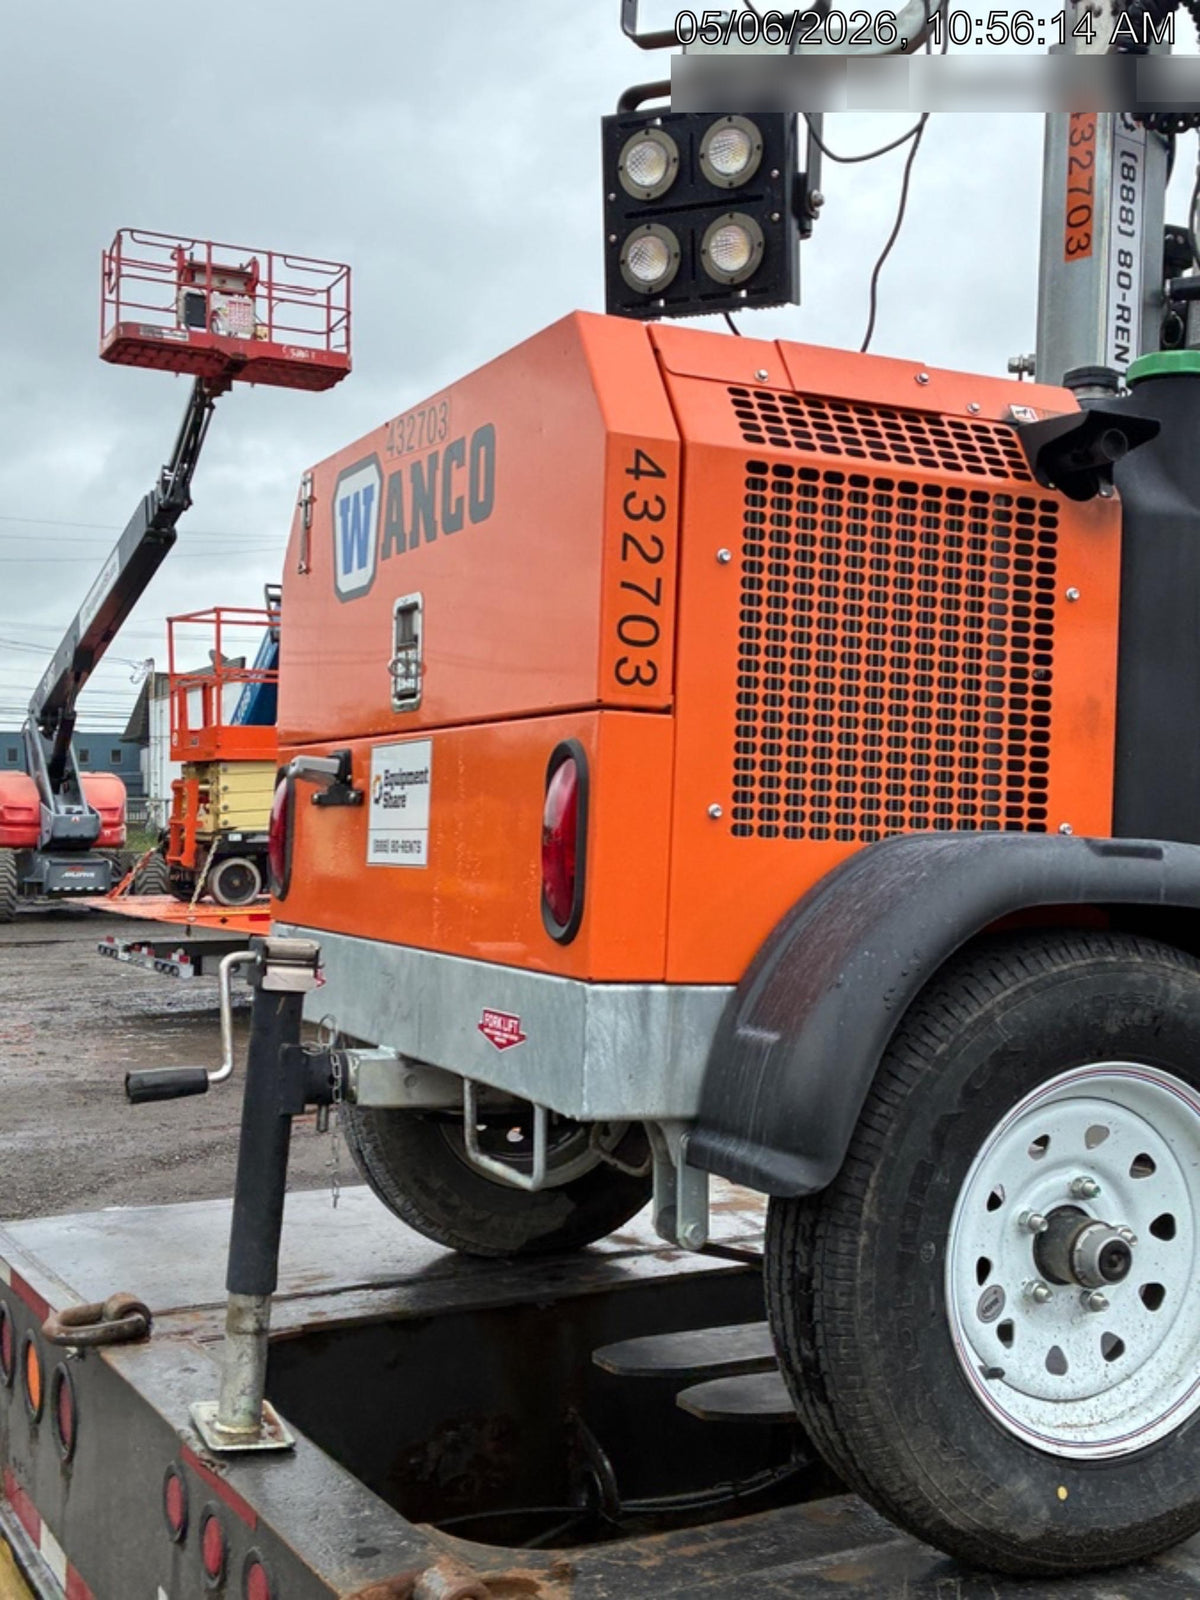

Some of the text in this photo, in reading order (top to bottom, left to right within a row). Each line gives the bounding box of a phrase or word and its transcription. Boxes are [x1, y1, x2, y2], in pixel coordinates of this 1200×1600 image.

[1117, 150, 1138, 238] (888)
[386, 401, 449, 457] 432703
[337, 423, 496, 578] WANCO
[614, 448, 667, 687] 432703
[383, 791, 406, 808] Share
[384, 767, 428, 790] Equipment
